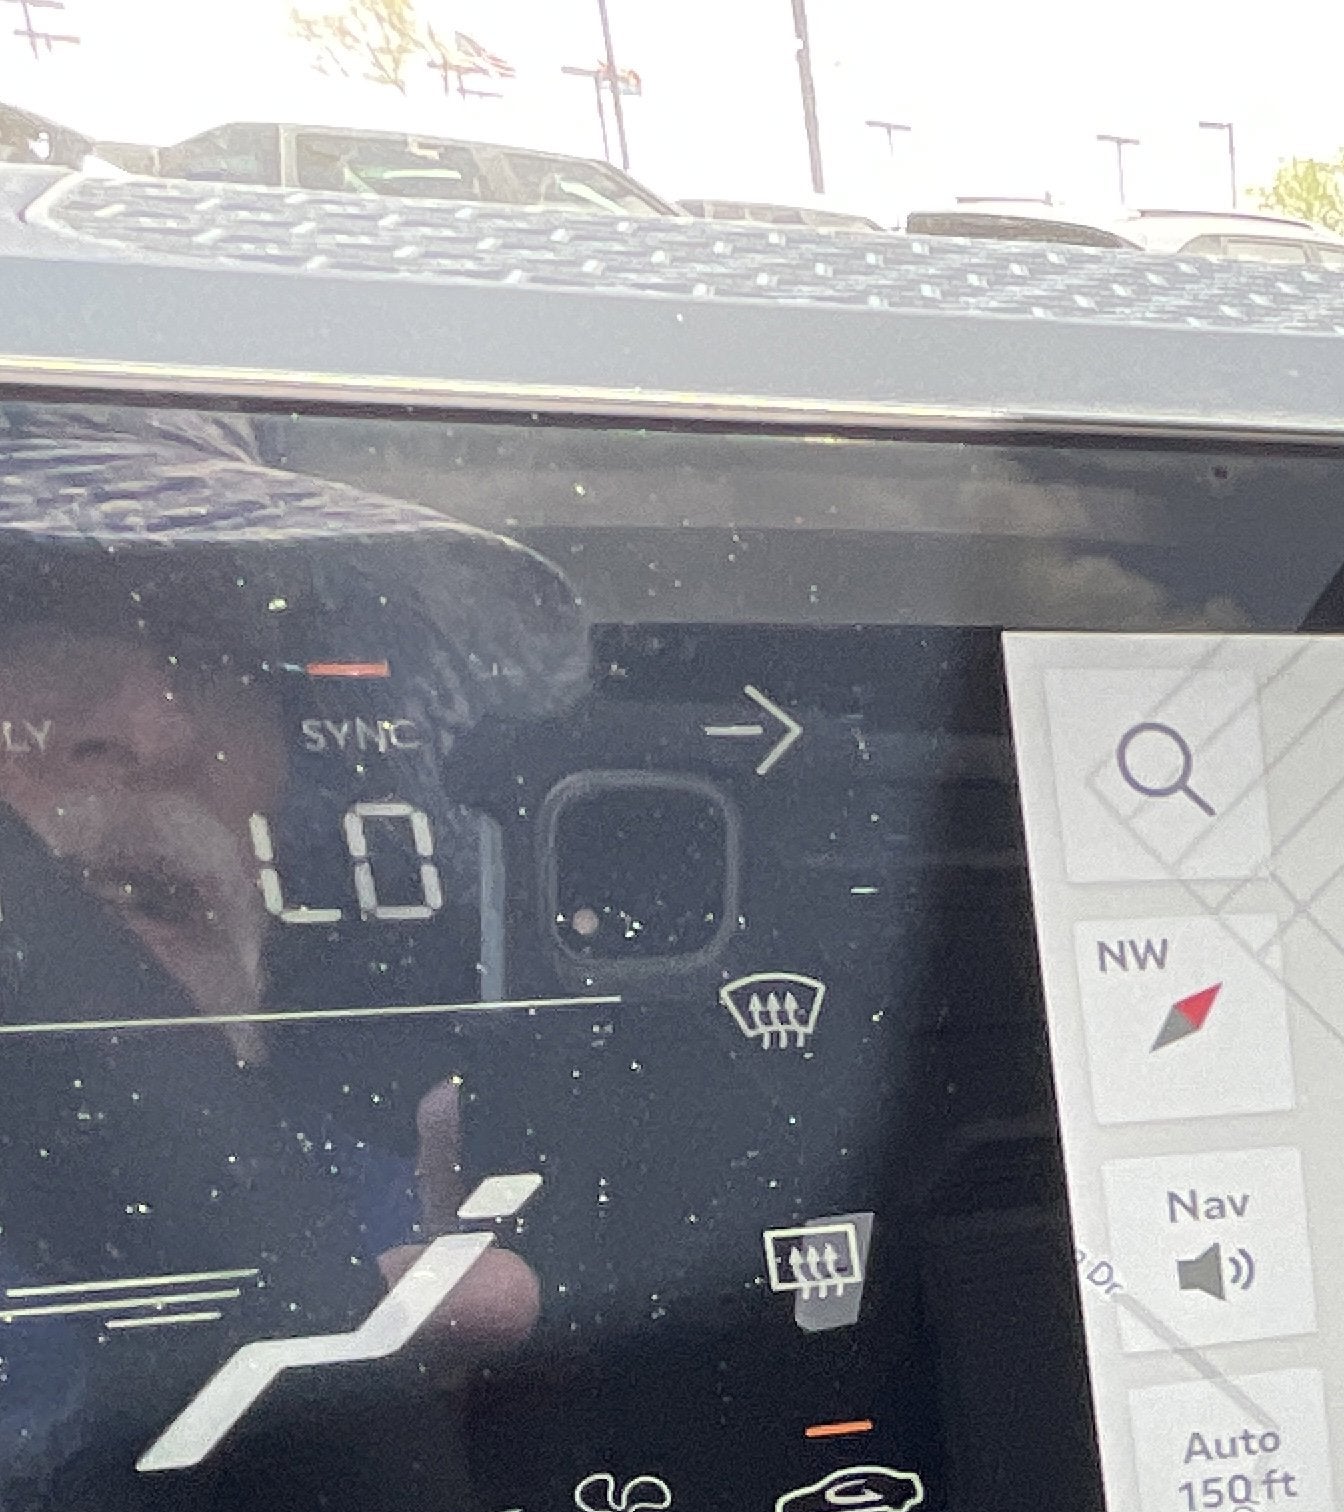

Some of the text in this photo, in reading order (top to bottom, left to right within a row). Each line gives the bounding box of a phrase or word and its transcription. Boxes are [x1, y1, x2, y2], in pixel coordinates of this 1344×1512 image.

[301, 716, 419, 754] SYNC
[1097, 938, 1169, 973] NW
[1167, 1191, 1250, 1224] Nav
[1183, 1429, 1281, 1464] Auto
[1178, 1469, 1298, 1512] 150 ft
